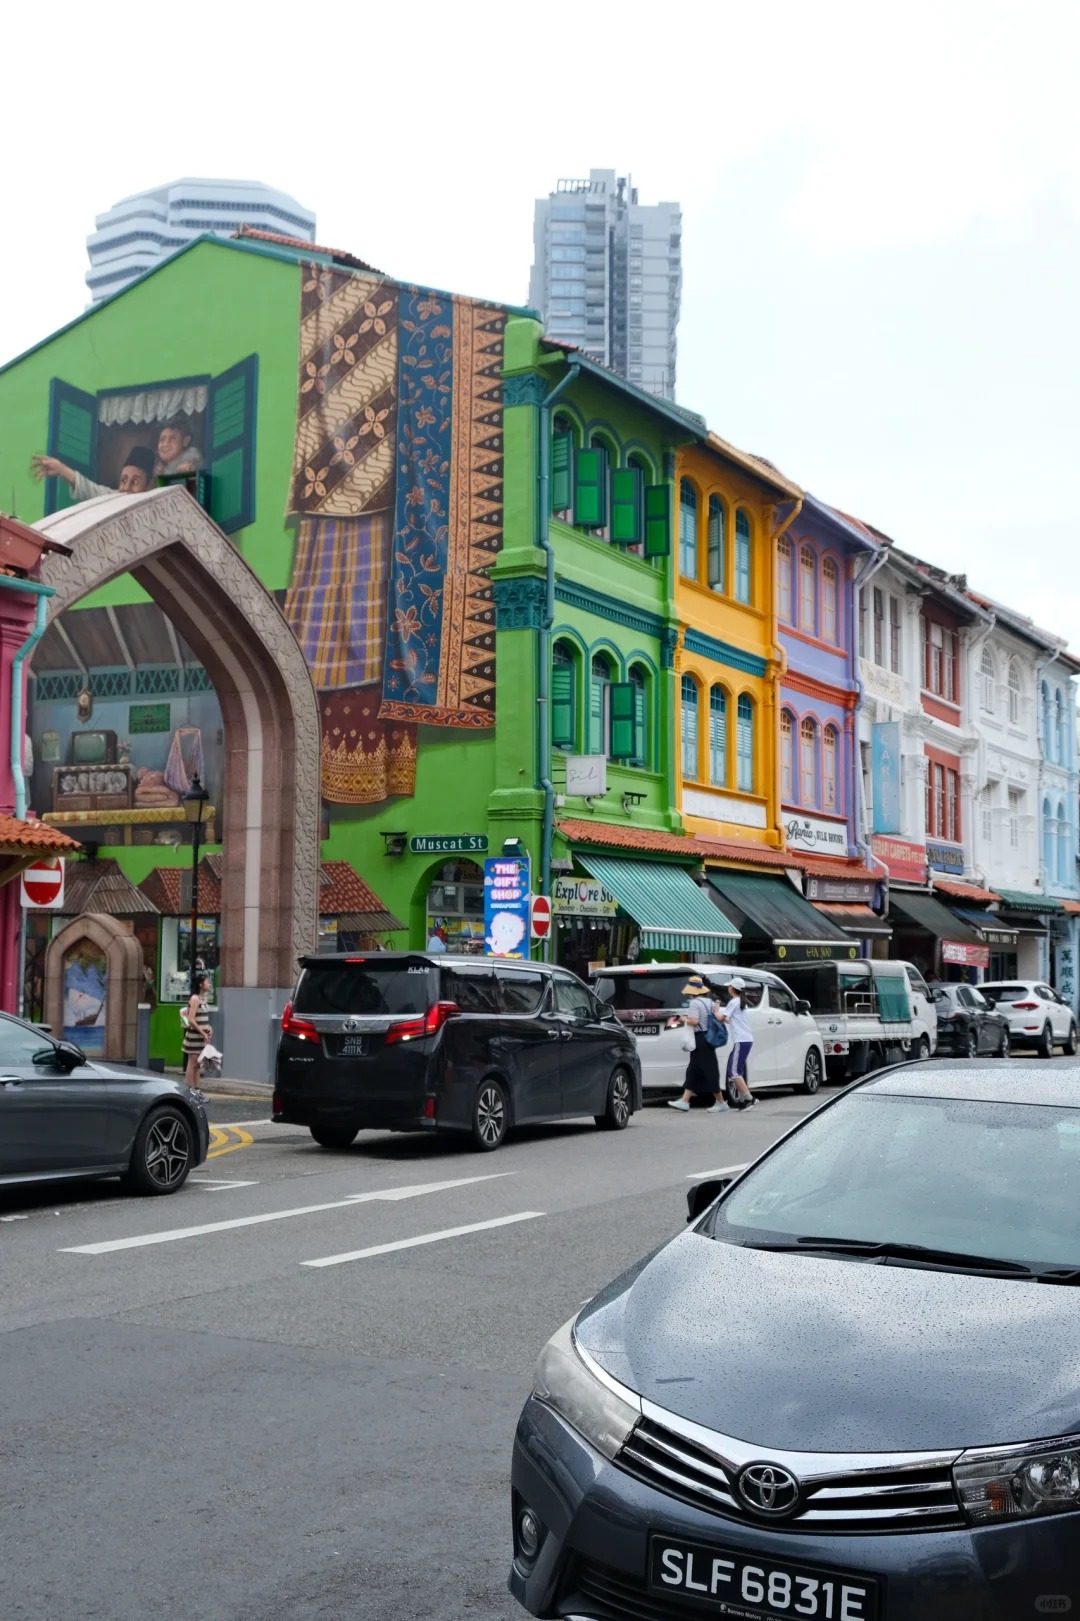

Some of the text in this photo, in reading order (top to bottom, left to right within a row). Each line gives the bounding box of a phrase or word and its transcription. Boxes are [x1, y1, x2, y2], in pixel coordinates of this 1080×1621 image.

[786, 820, 844, 844] Rania SILK HOUSE
[416, 837, 483, 850] Muscat St
[494, 863, 517, 874] THE
[493, 876, 518, 887] GIFT
[490, 889, 522, 900] SHOP
[1060, 950, 1075, 1007] 萬順成
[344, 1036, 362, 1045] SNB
[660, 1548, 867, 1621] SLF6831E
[727, 1608, 744, 1617] Borneo
[745, 1611, 762, 1620] Motors
